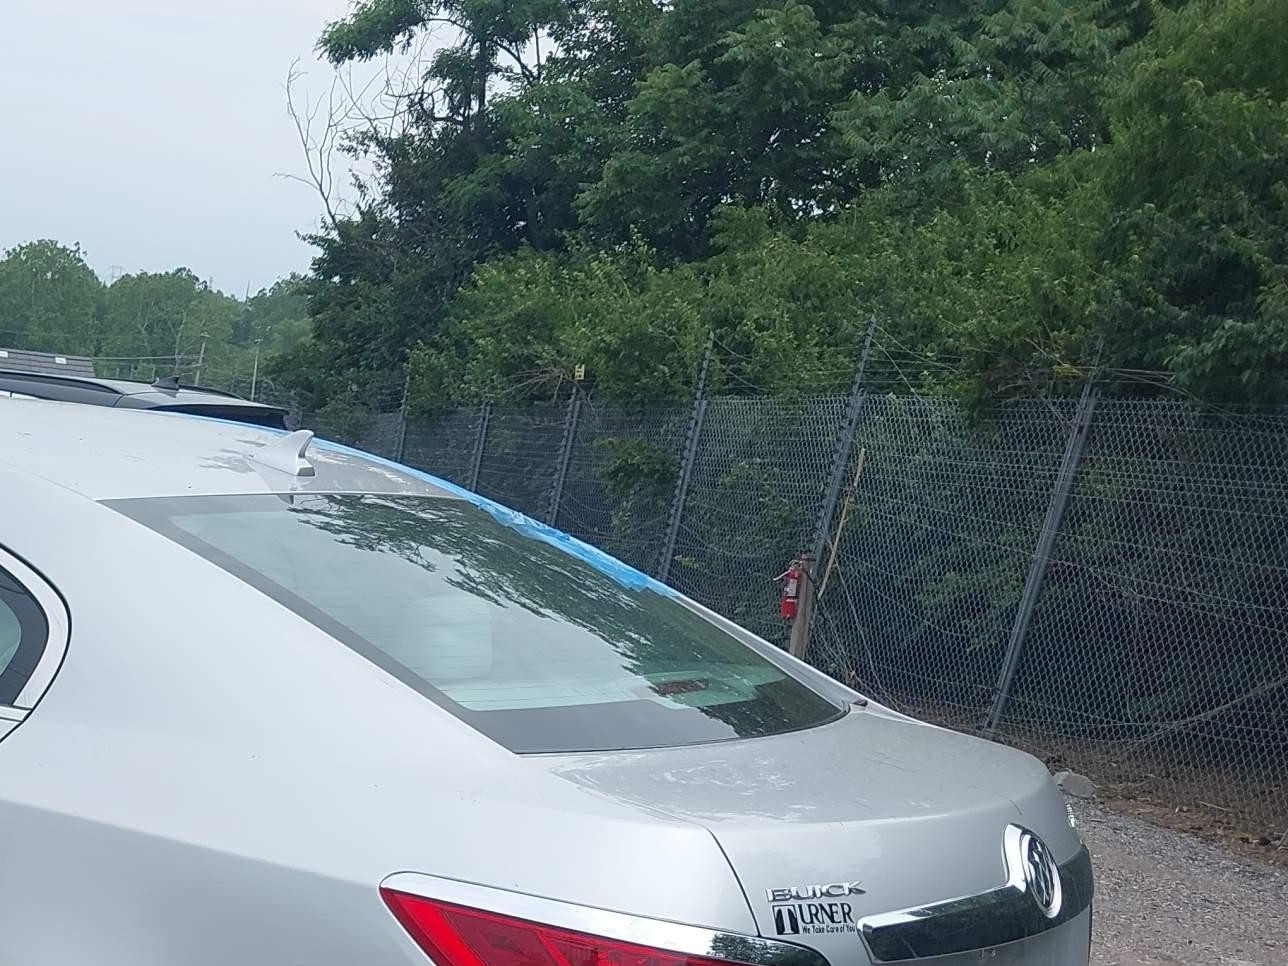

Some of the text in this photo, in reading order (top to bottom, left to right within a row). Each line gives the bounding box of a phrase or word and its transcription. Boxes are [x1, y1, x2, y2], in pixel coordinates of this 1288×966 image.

[765, 880, 867, 903] BUICK
[772, 902, 854, 935] TURNER
[802, 923, 856, 935] We Take Care of You
